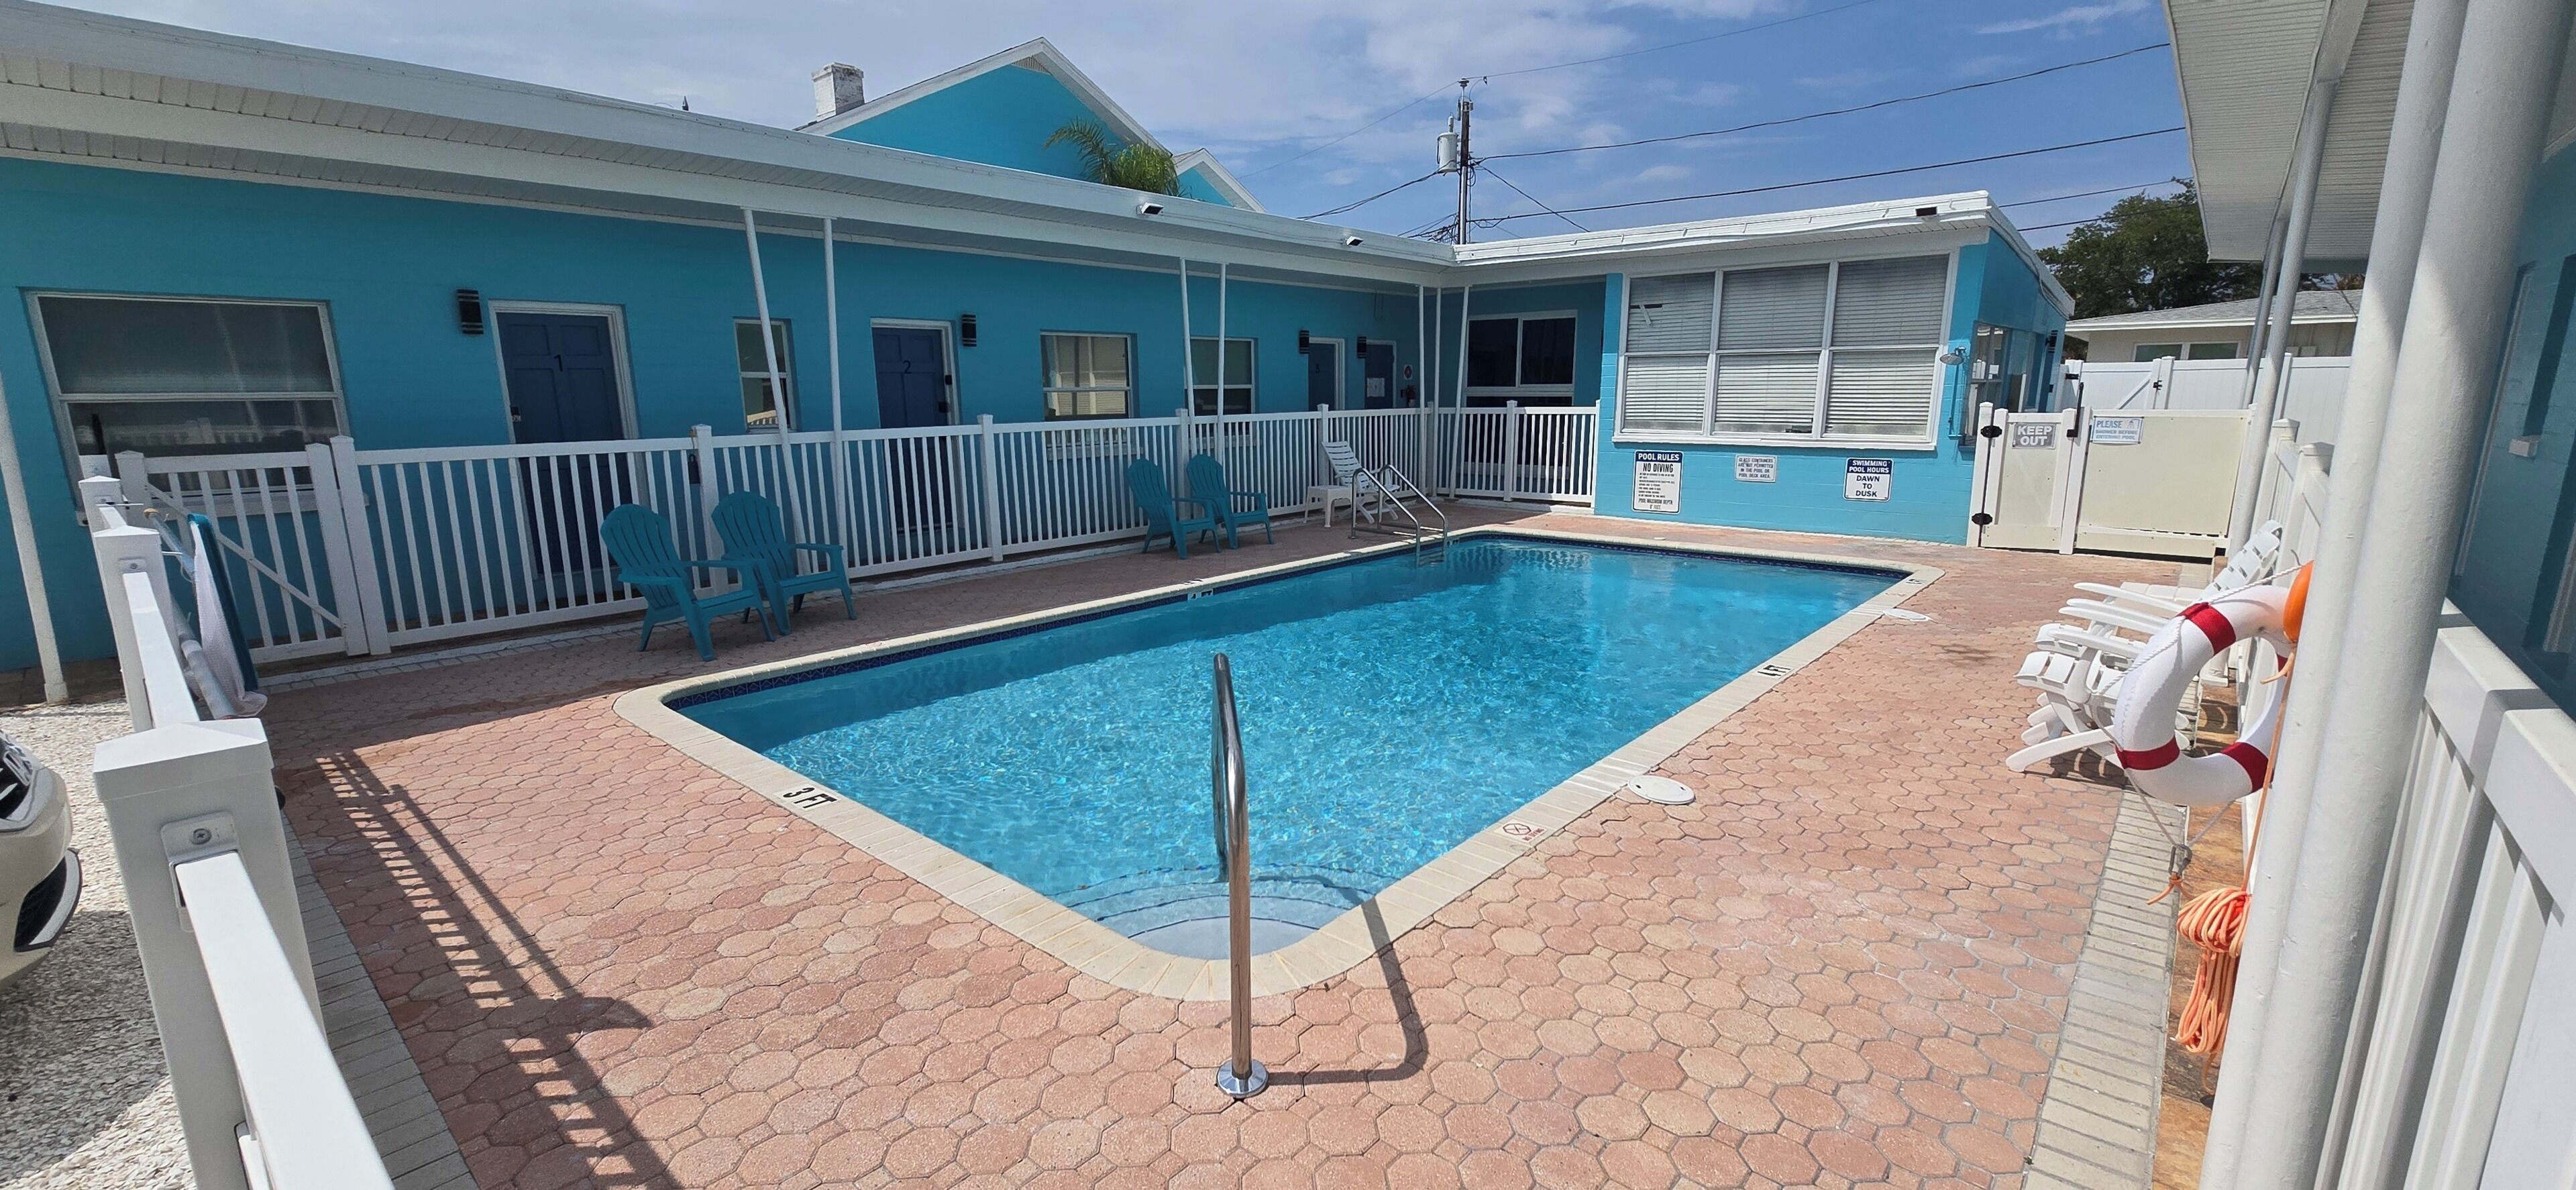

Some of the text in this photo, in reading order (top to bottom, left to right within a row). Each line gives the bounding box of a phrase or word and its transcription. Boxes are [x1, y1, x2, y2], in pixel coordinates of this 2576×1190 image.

[554, 355, 563, 372] 1
[903, 360, 912, 374] 2
[2017, 425, 2052, 435] KEEP
[2020, 436, 2047, 445] OUT
[1643, 463, 1674, 473] NO DIVING
[1763, 665, 1791, 673] FT
[783, 788, 838, 808] 3 FT
